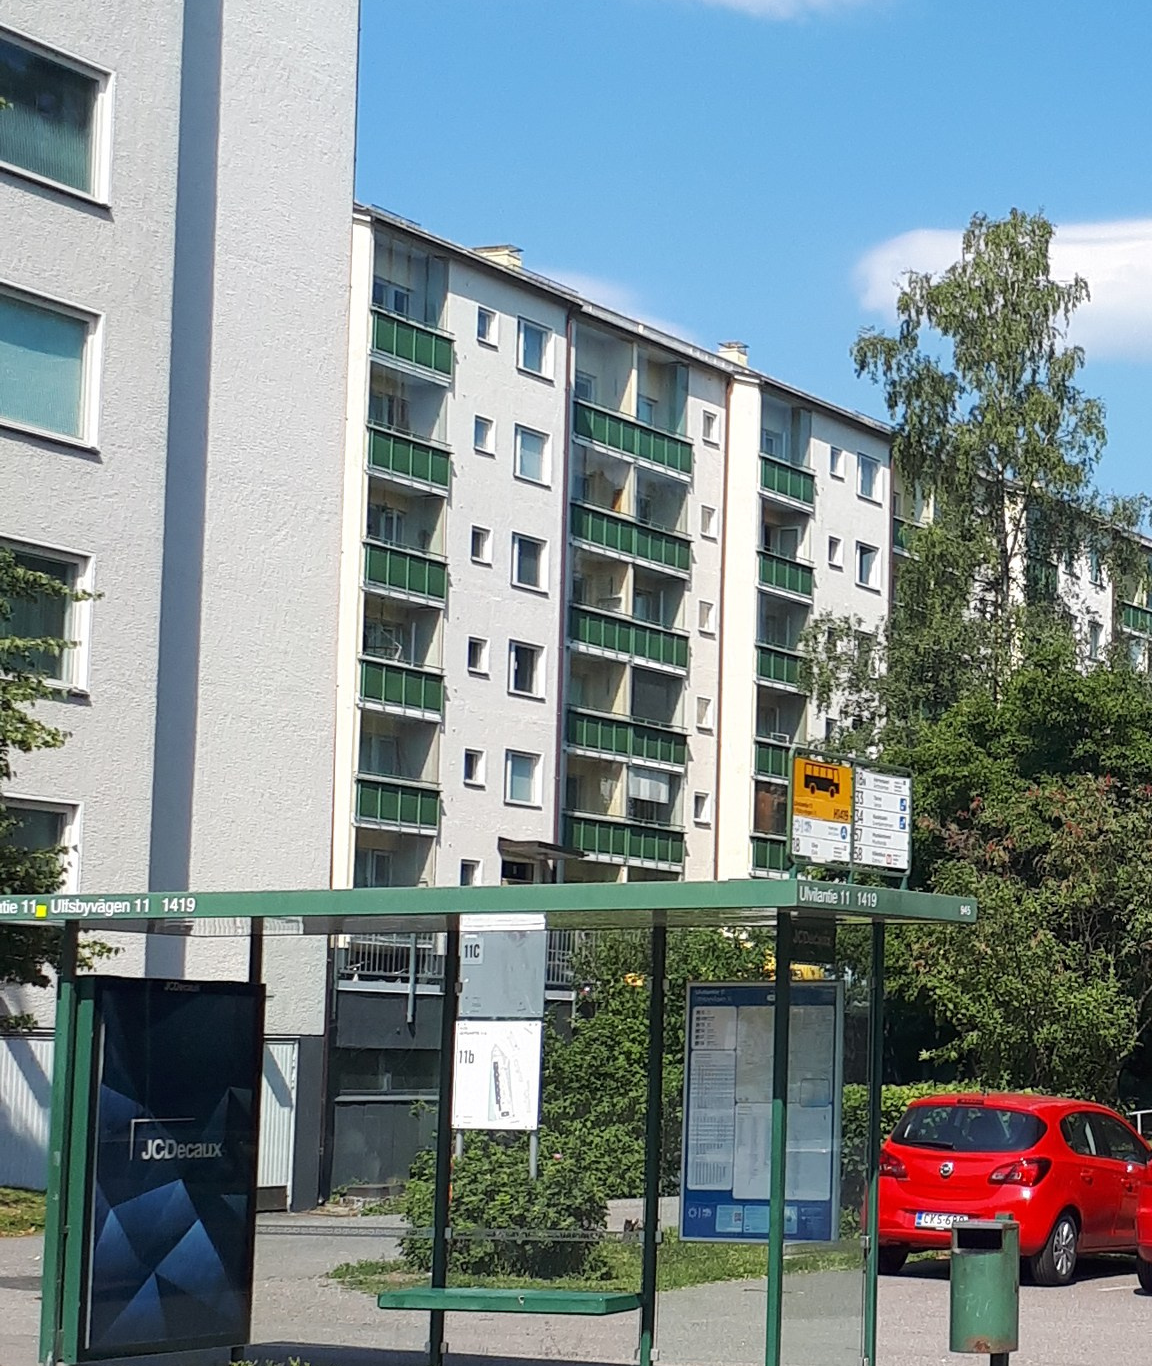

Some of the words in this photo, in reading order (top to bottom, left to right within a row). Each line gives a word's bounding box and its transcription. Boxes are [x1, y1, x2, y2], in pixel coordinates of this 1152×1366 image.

[800, 886, 838, 904] Ulvilantie
[840, 890, 850, 905] 11
[857, 892, 877, 907] 1419
[21, 899, 37, 914] 11
[134, 898, 150, 913] 11
[162, 897, 196, 913] 1419
[464, 944, 480, 958] 11C
[459, 1050, 474, 1064] 11b
[141, 1139, 222, 1160] JCDecaux
